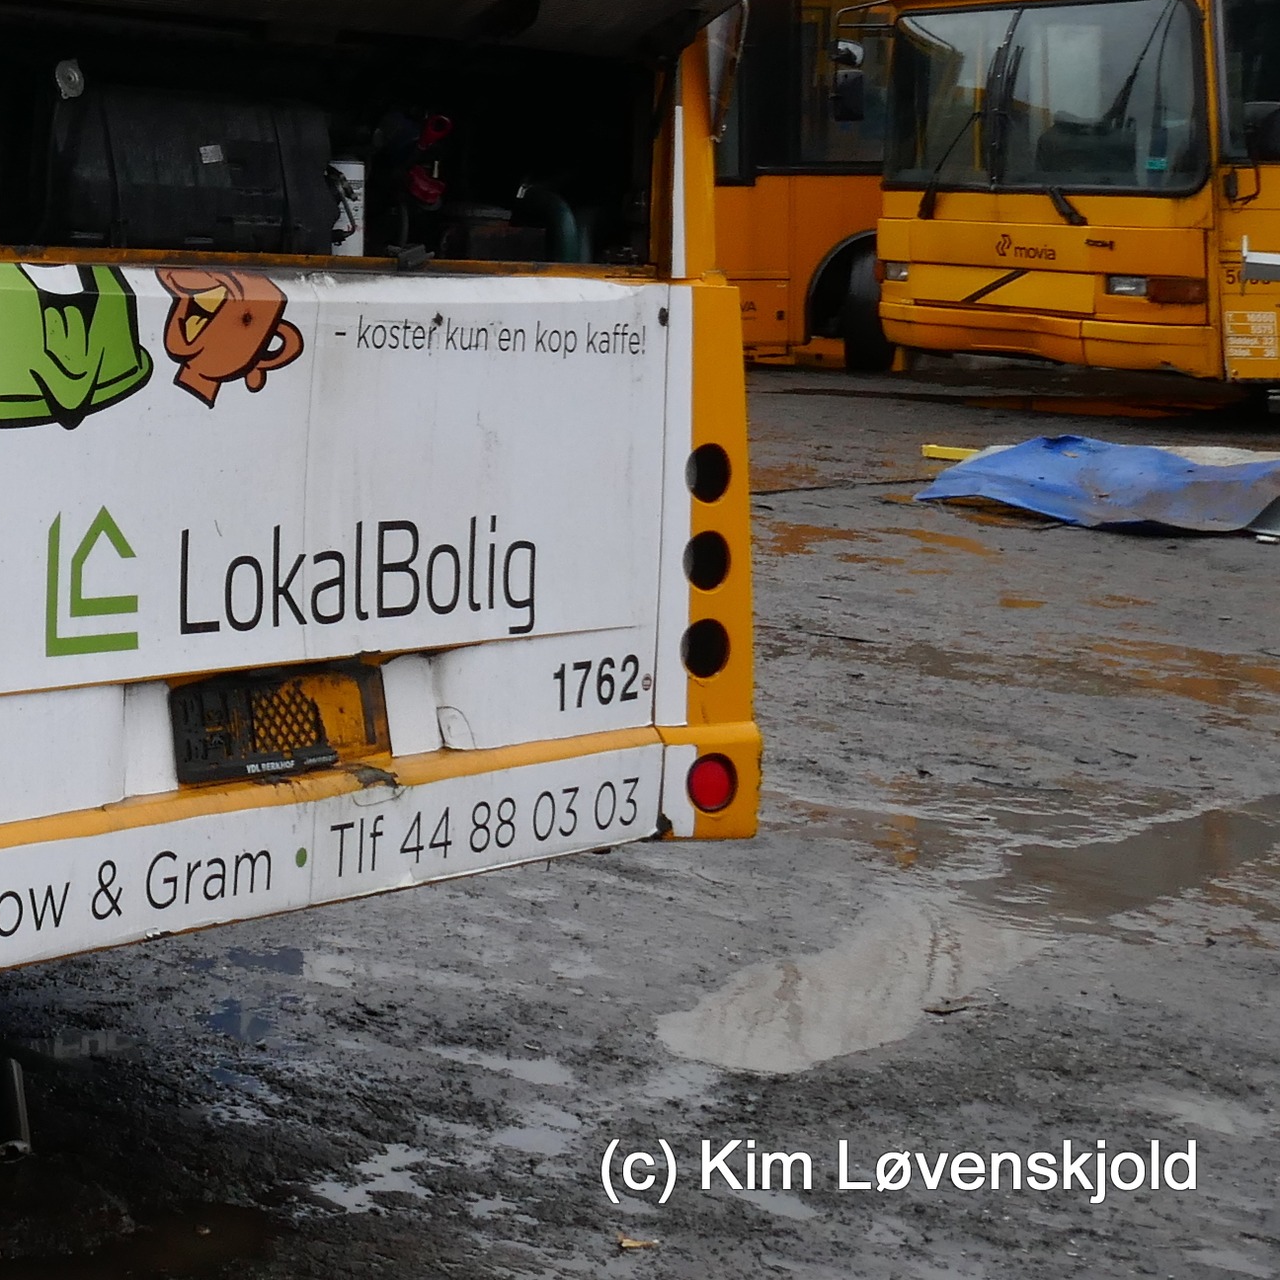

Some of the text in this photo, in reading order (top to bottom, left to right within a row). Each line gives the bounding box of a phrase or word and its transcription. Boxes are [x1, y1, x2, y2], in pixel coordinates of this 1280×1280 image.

[1014, 244, 1056, 260] movia
[356, 314, 438, 351] koster
[445, 317, 489, 351] kun
[498, 327, 526, 353] en
[534, 320, 578, 360] kop
[586, 322, 646, 356] kaffe!
[179, 514, 537, 635] LokalBolig
[553, 654, 640, 712] 1762
[91, 858, 124, 921] &
[146, 849, 272, 910] Gram
[330, 814, 385, 878] Tlf
[399, 806, 453, 864] 44
[469, 797, 516, 853] 88
[532, 786, 580, 842] 03
[594, 776, 640, 831] 03
